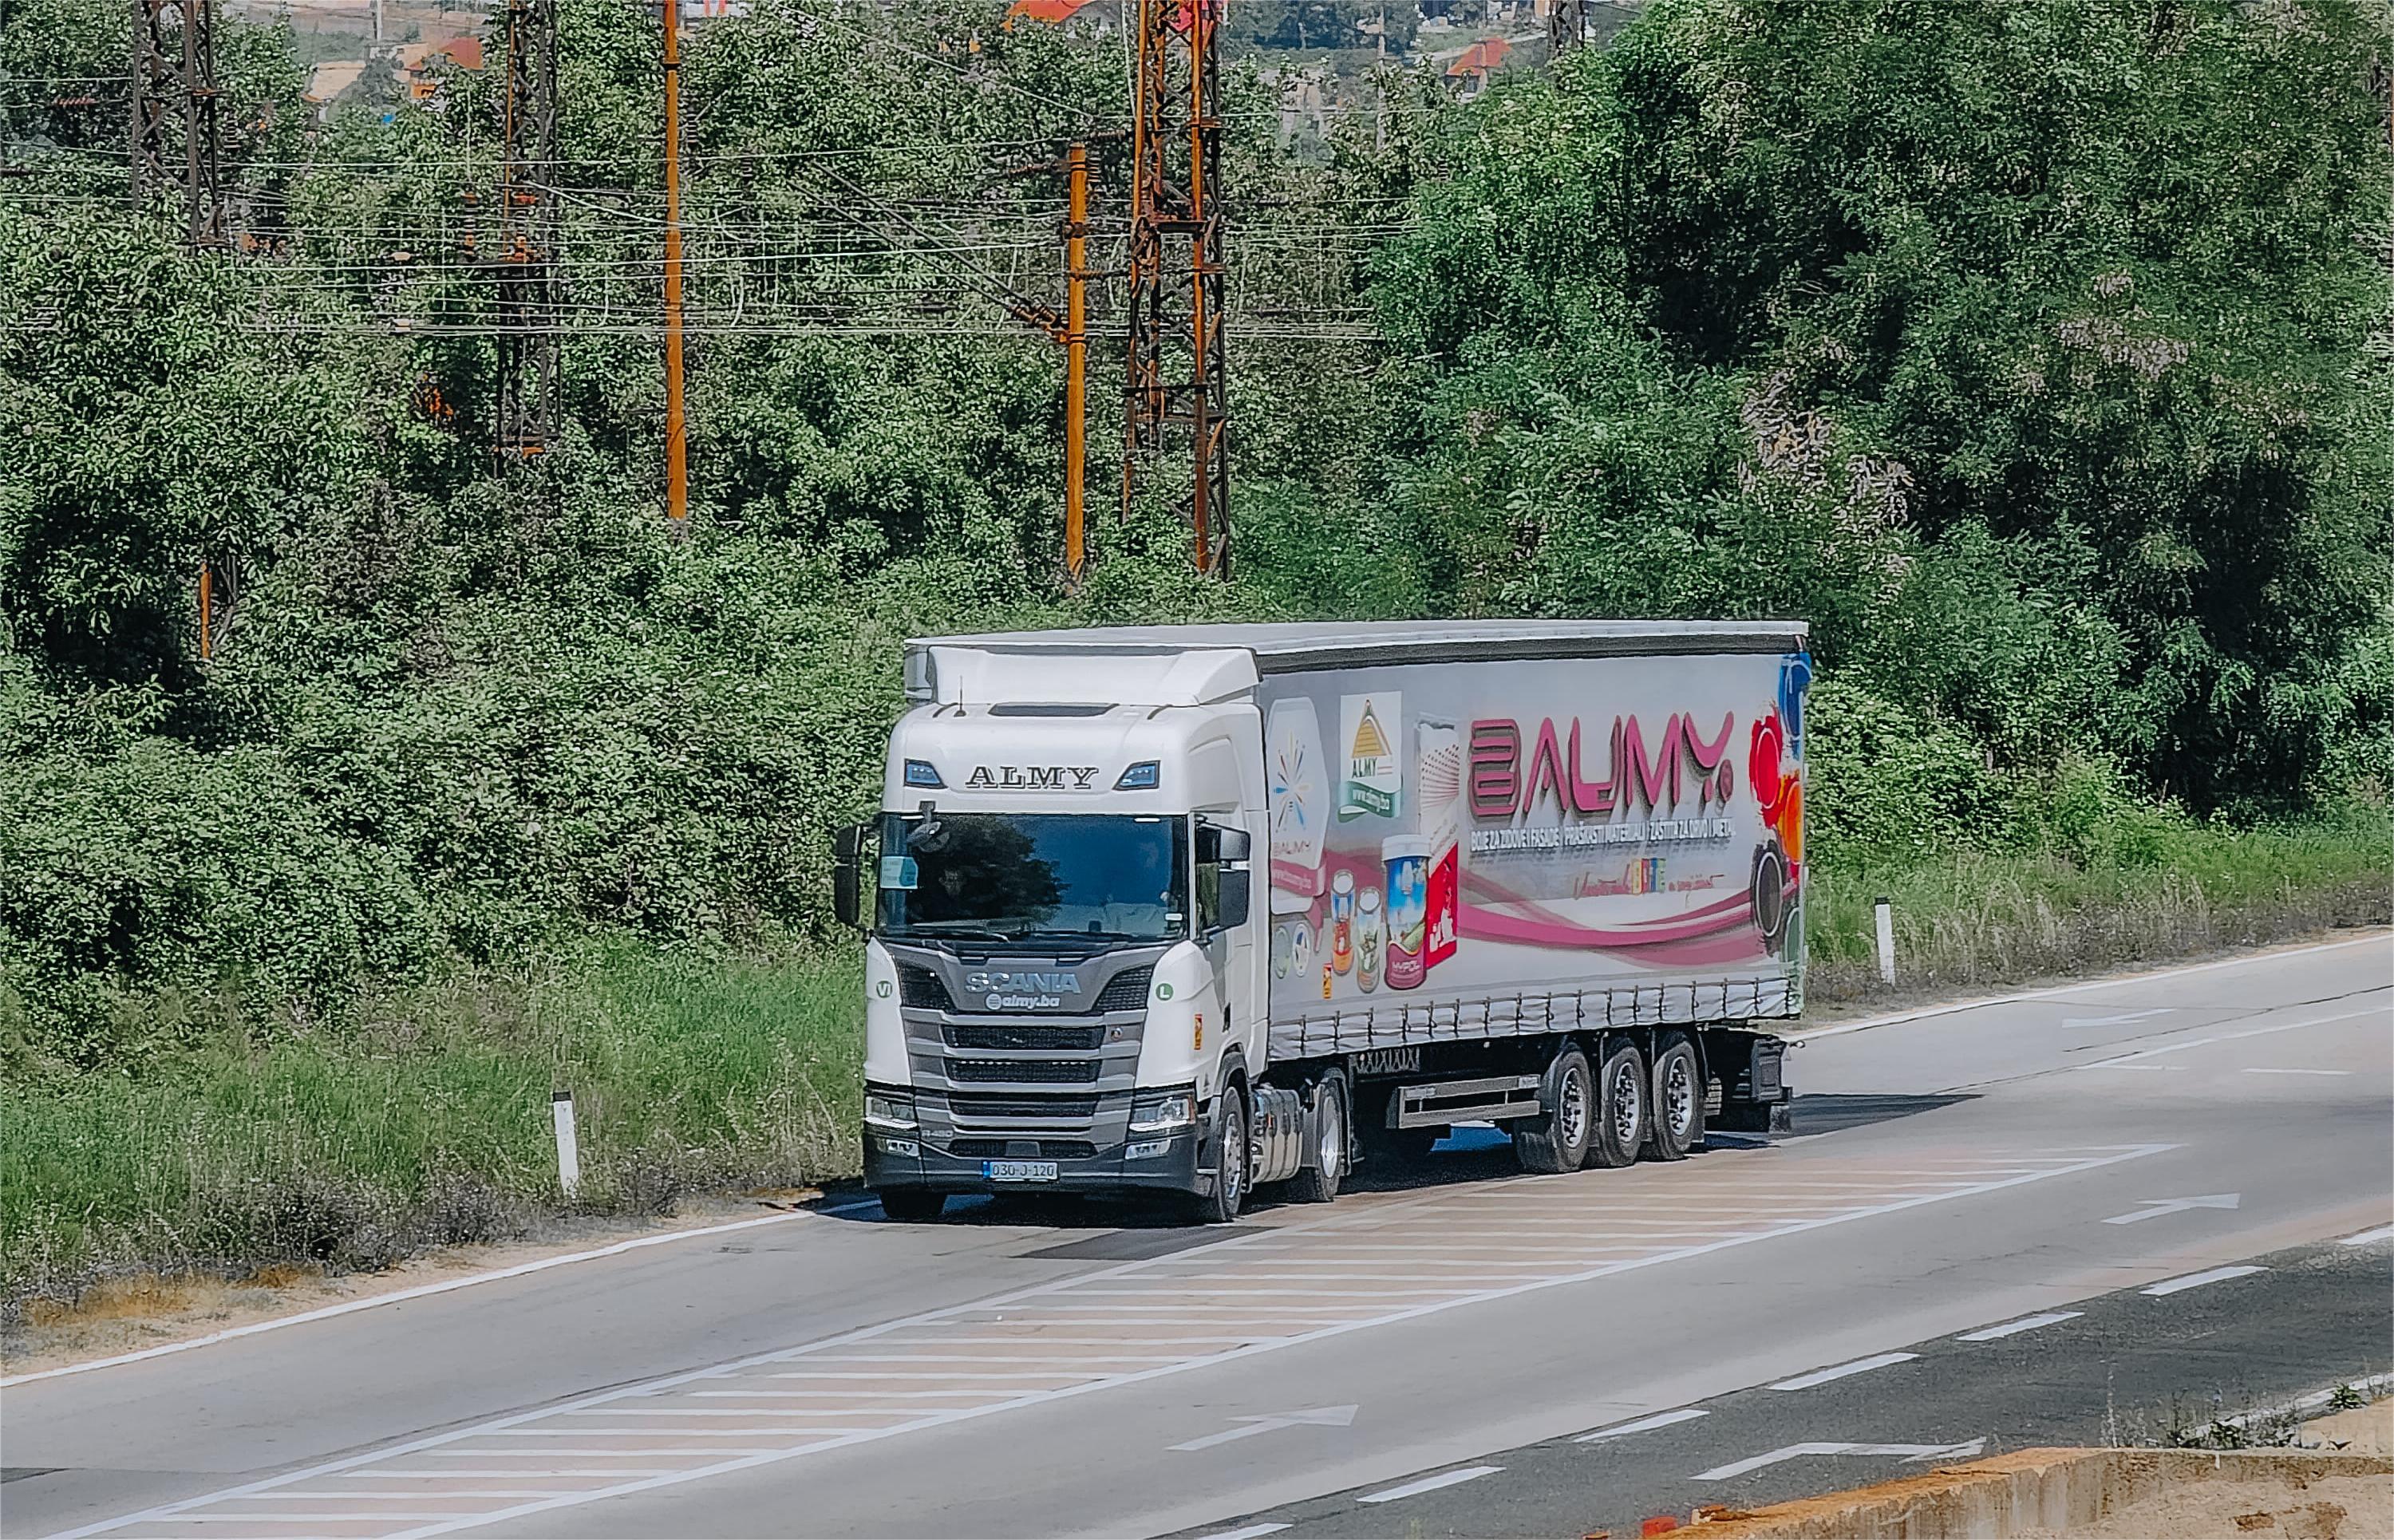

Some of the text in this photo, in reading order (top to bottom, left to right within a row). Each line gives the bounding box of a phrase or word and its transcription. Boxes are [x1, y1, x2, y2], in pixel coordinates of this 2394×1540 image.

[965, 766, 1099, 789] ALMY
[1352, 757, 1377, 779] ALMY
[965, 972, 1082, 993] SCANIA
